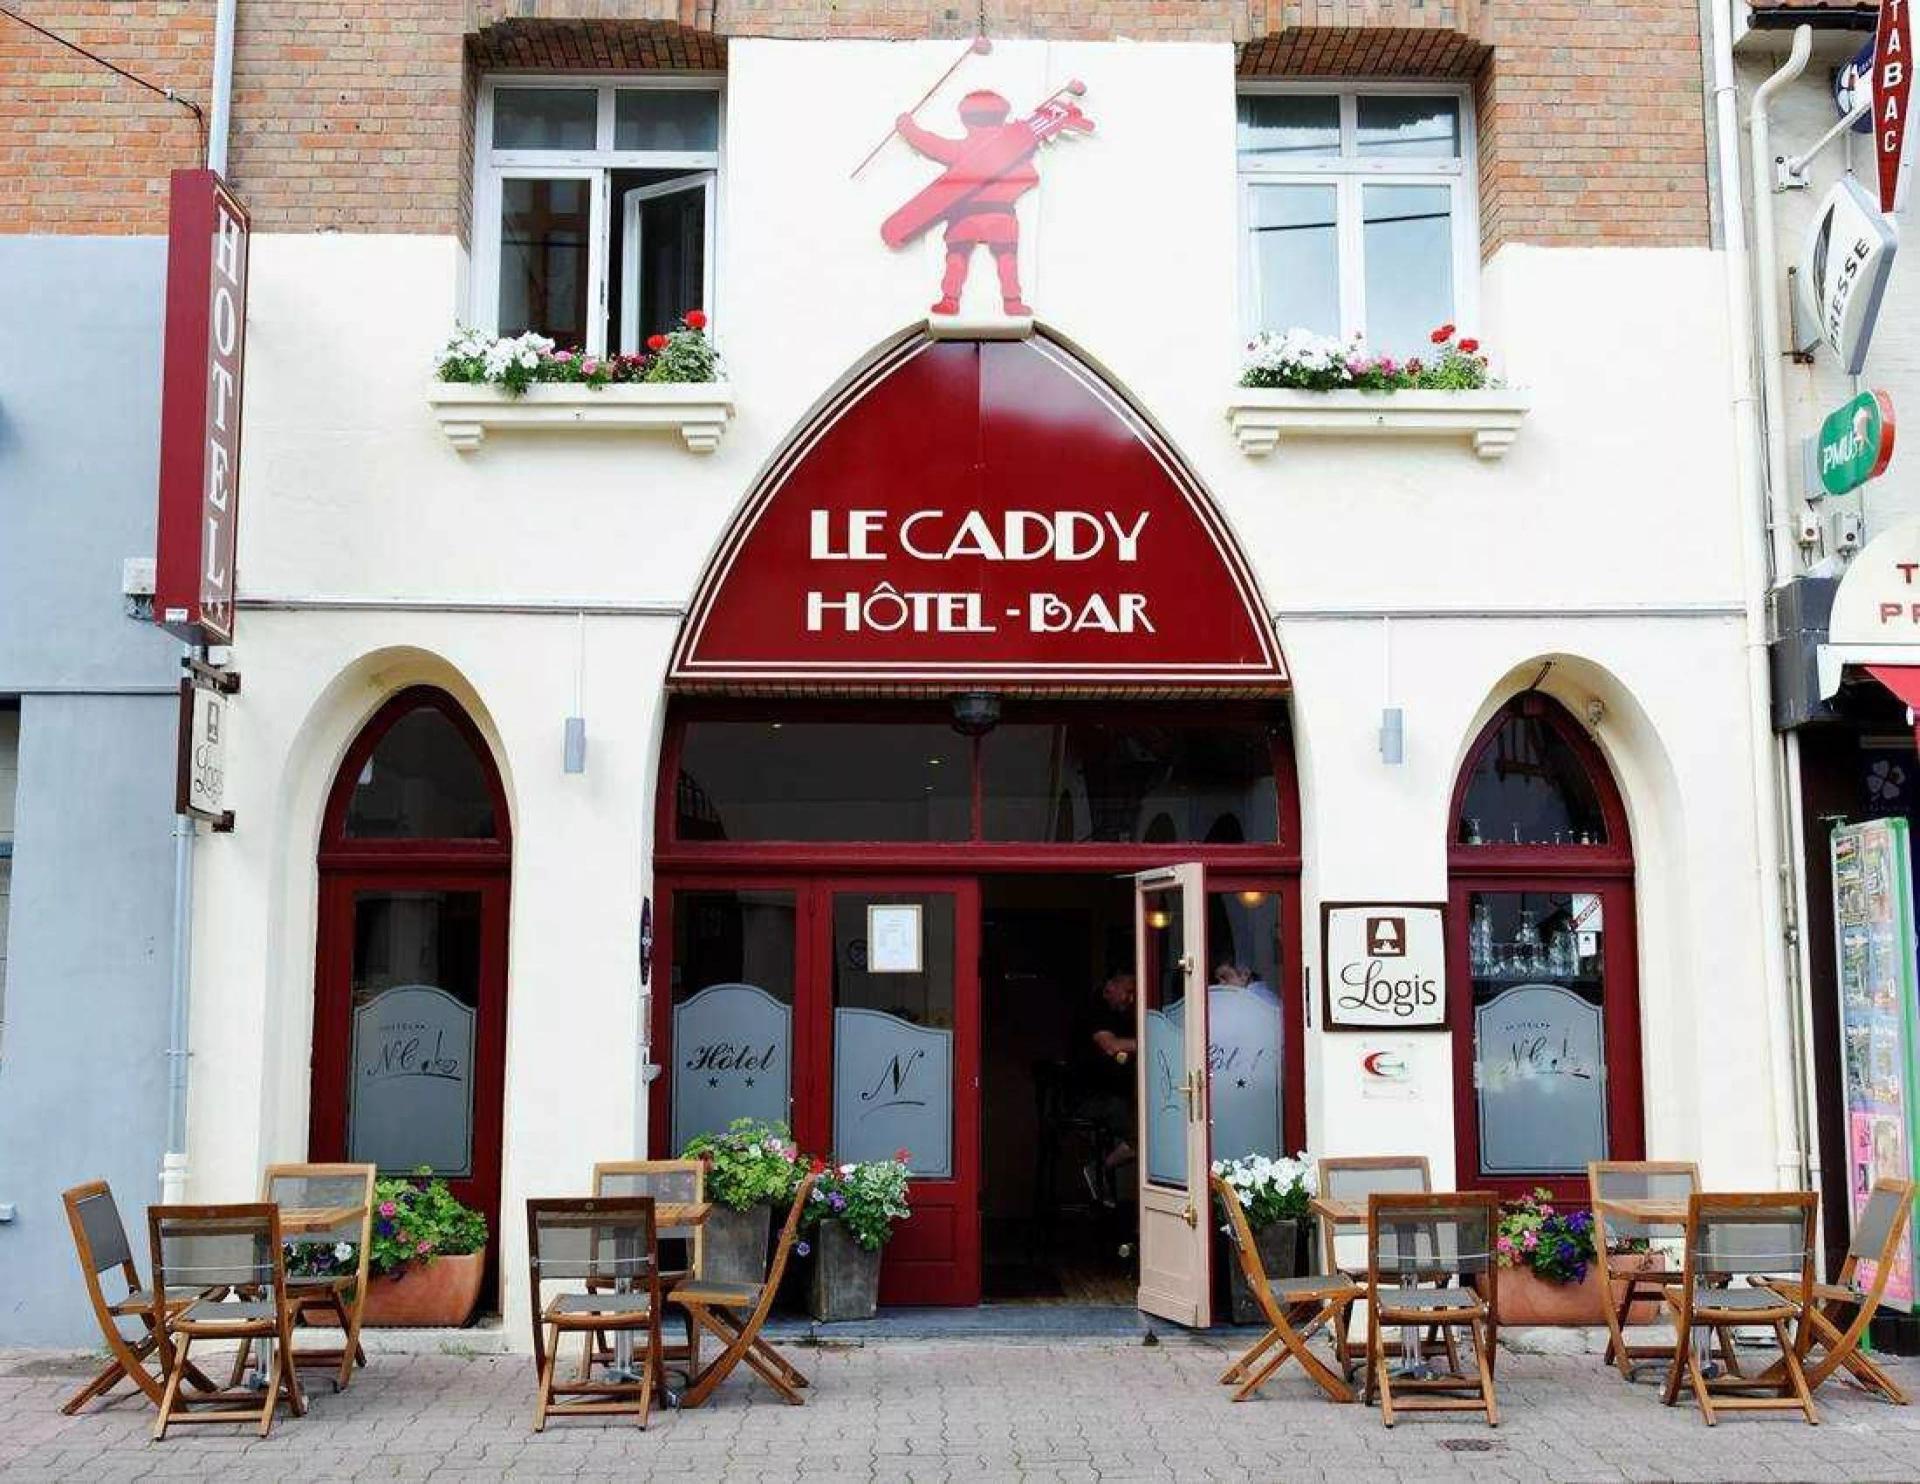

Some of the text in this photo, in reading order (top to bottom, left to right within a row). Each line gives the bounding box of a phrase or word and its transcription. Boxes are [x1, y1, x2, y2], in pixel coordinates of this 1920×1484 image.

[1882, 0, 1904, 152] TABAC
[206, 206, 240, 588] HOTEL
[1823, 428, 1853, 475] PMU
[810, 509, 1150, 561] LE CADDY
[807, 580, 996, 633] HÔTEL
[1029, 592, 1156, 633] BAR
[1338, 959, 1438, 1017] Logis
[685, 1041, 776, 1073] Hôtel
